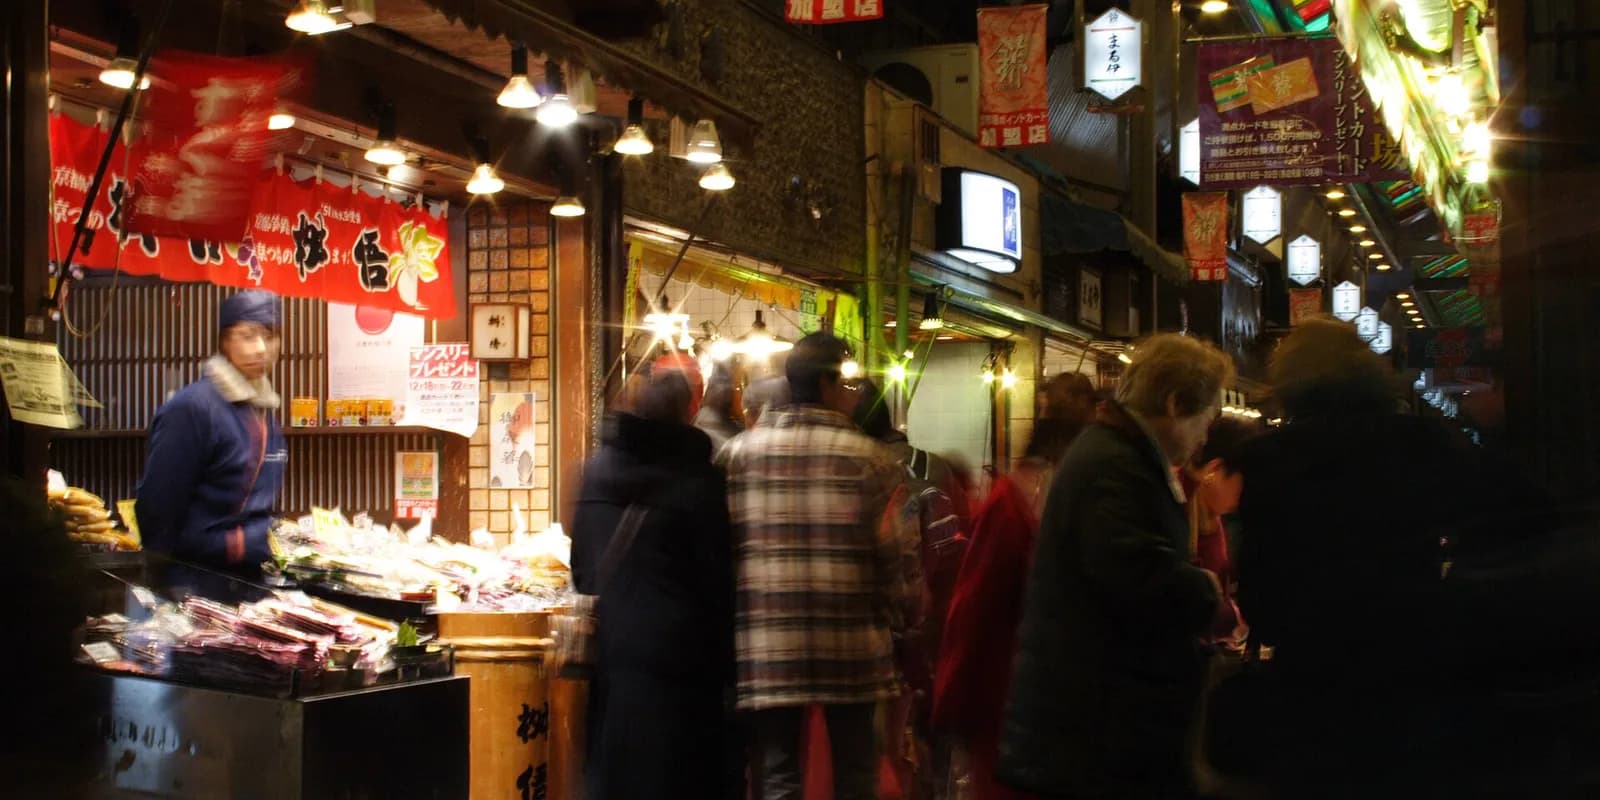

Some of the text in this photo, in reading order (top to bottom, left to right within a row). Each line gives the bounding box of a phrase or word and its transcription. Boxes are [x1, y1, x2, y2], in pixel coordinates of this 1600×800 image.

[410, 360, 477, 377] プレゼント
